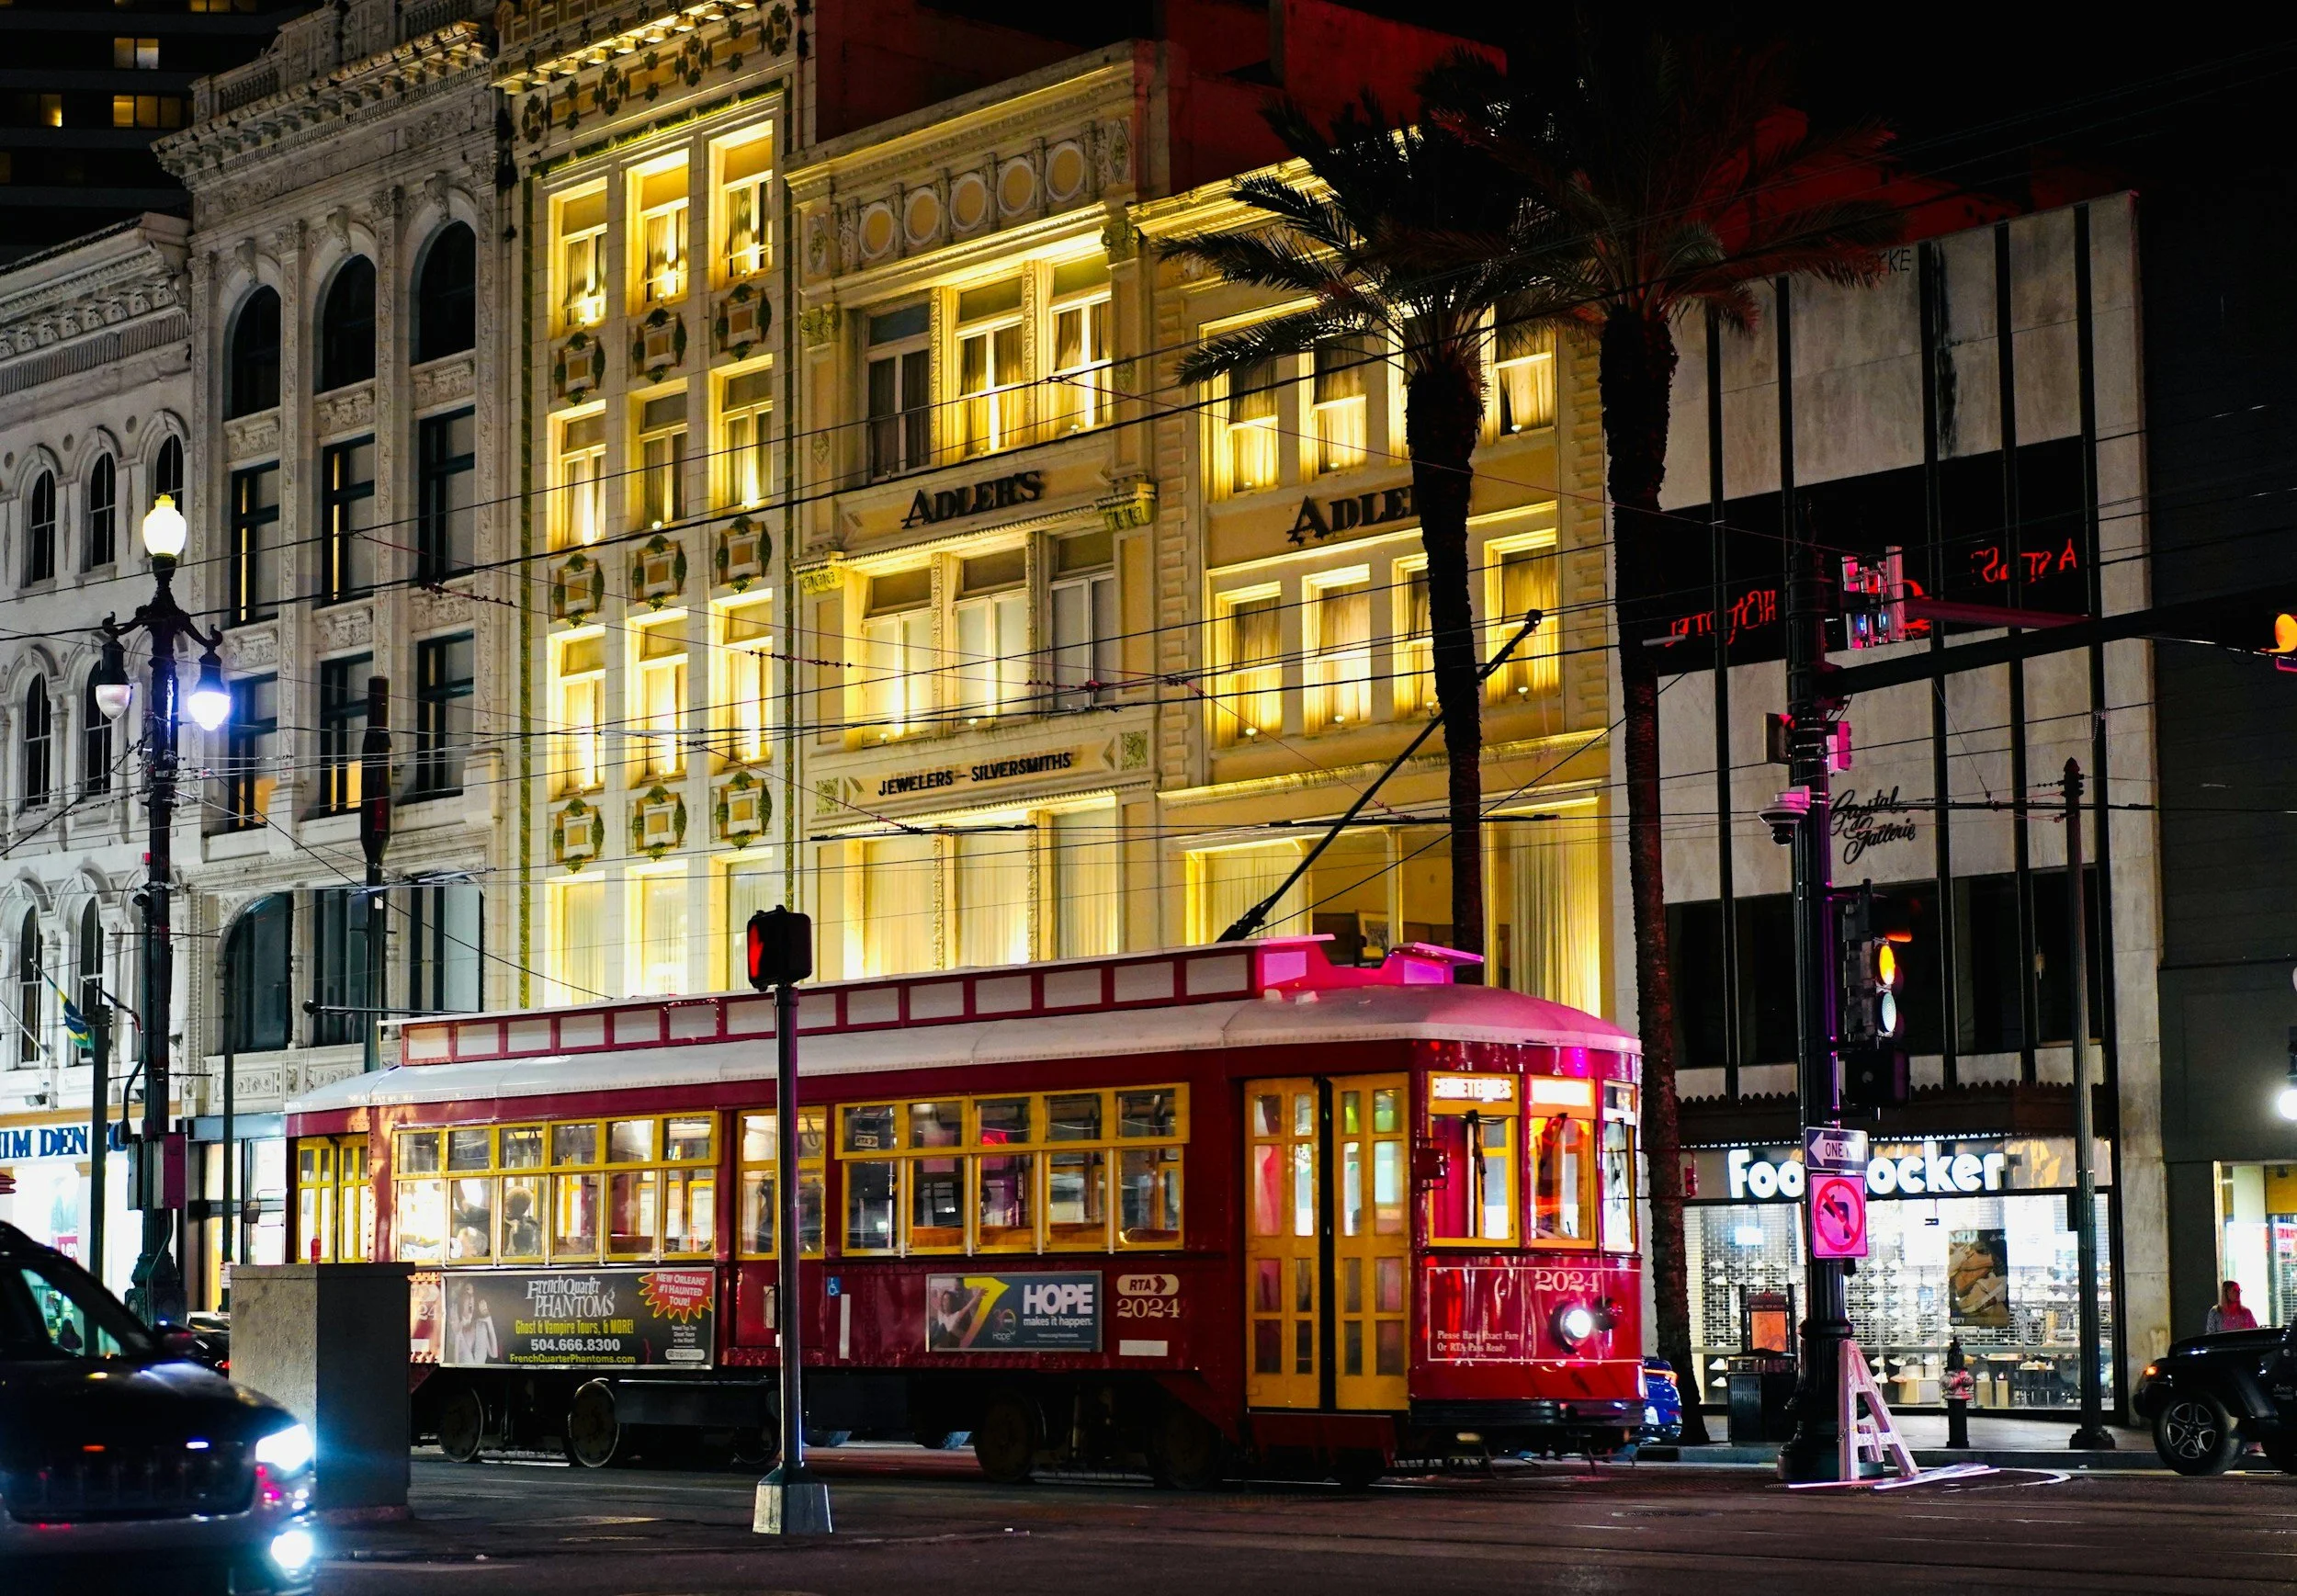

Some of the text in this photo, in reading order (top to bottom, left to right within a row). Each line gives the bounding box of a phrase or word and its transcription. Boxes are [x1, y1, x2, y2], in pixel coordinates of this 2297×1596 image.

[1286, 494, 1420, 545] ADLE
[877, 770, 954, 797] JEWELERS
[971, 752, 1071, 782] SILVERSMITHS
[1843, 816, 1916, 865] Gallerie
[1825, 1142, 1843, 1158] ONE
[1728, 1141, 2005, 1199] Foo ocker
[656, 1273, 673, 1283] NEW
[1129, 1279, 1151, 1291] RTA
[1534, 1271, 1600, 1293] 2024
[659, 1285, 703, 1296] #1 HAUNTED
[535, 1294, 615, 1318] PHANTOMS
[669, 1296, 691, 1307] TOUR!
[1024, 1284, 1093, 1315] HOPE
[1117, 1297, 1180, 1319] 2024
[515, 1320, 537, 1334] Ghost
[545, 1319, 575, 1336] Vampire
[577, 1319, 601, 1336] Tours,
[610, 1319, 634, 1334] MORE!
[1023, 1316, 1049, 1326] makes
[1051, 1316, 1058, 1326] it
[1437, 1330, 1460, 1340] Please
[1504, 1330, 1519, 1340] Fare
[530, 1339, 621, 1352] 504.666.8300
[1437, 1342, 1507, 1353] Or RTA Pass Ready
[509, 1353, 636, 1364] FrenchQuarterPhantoms.com
